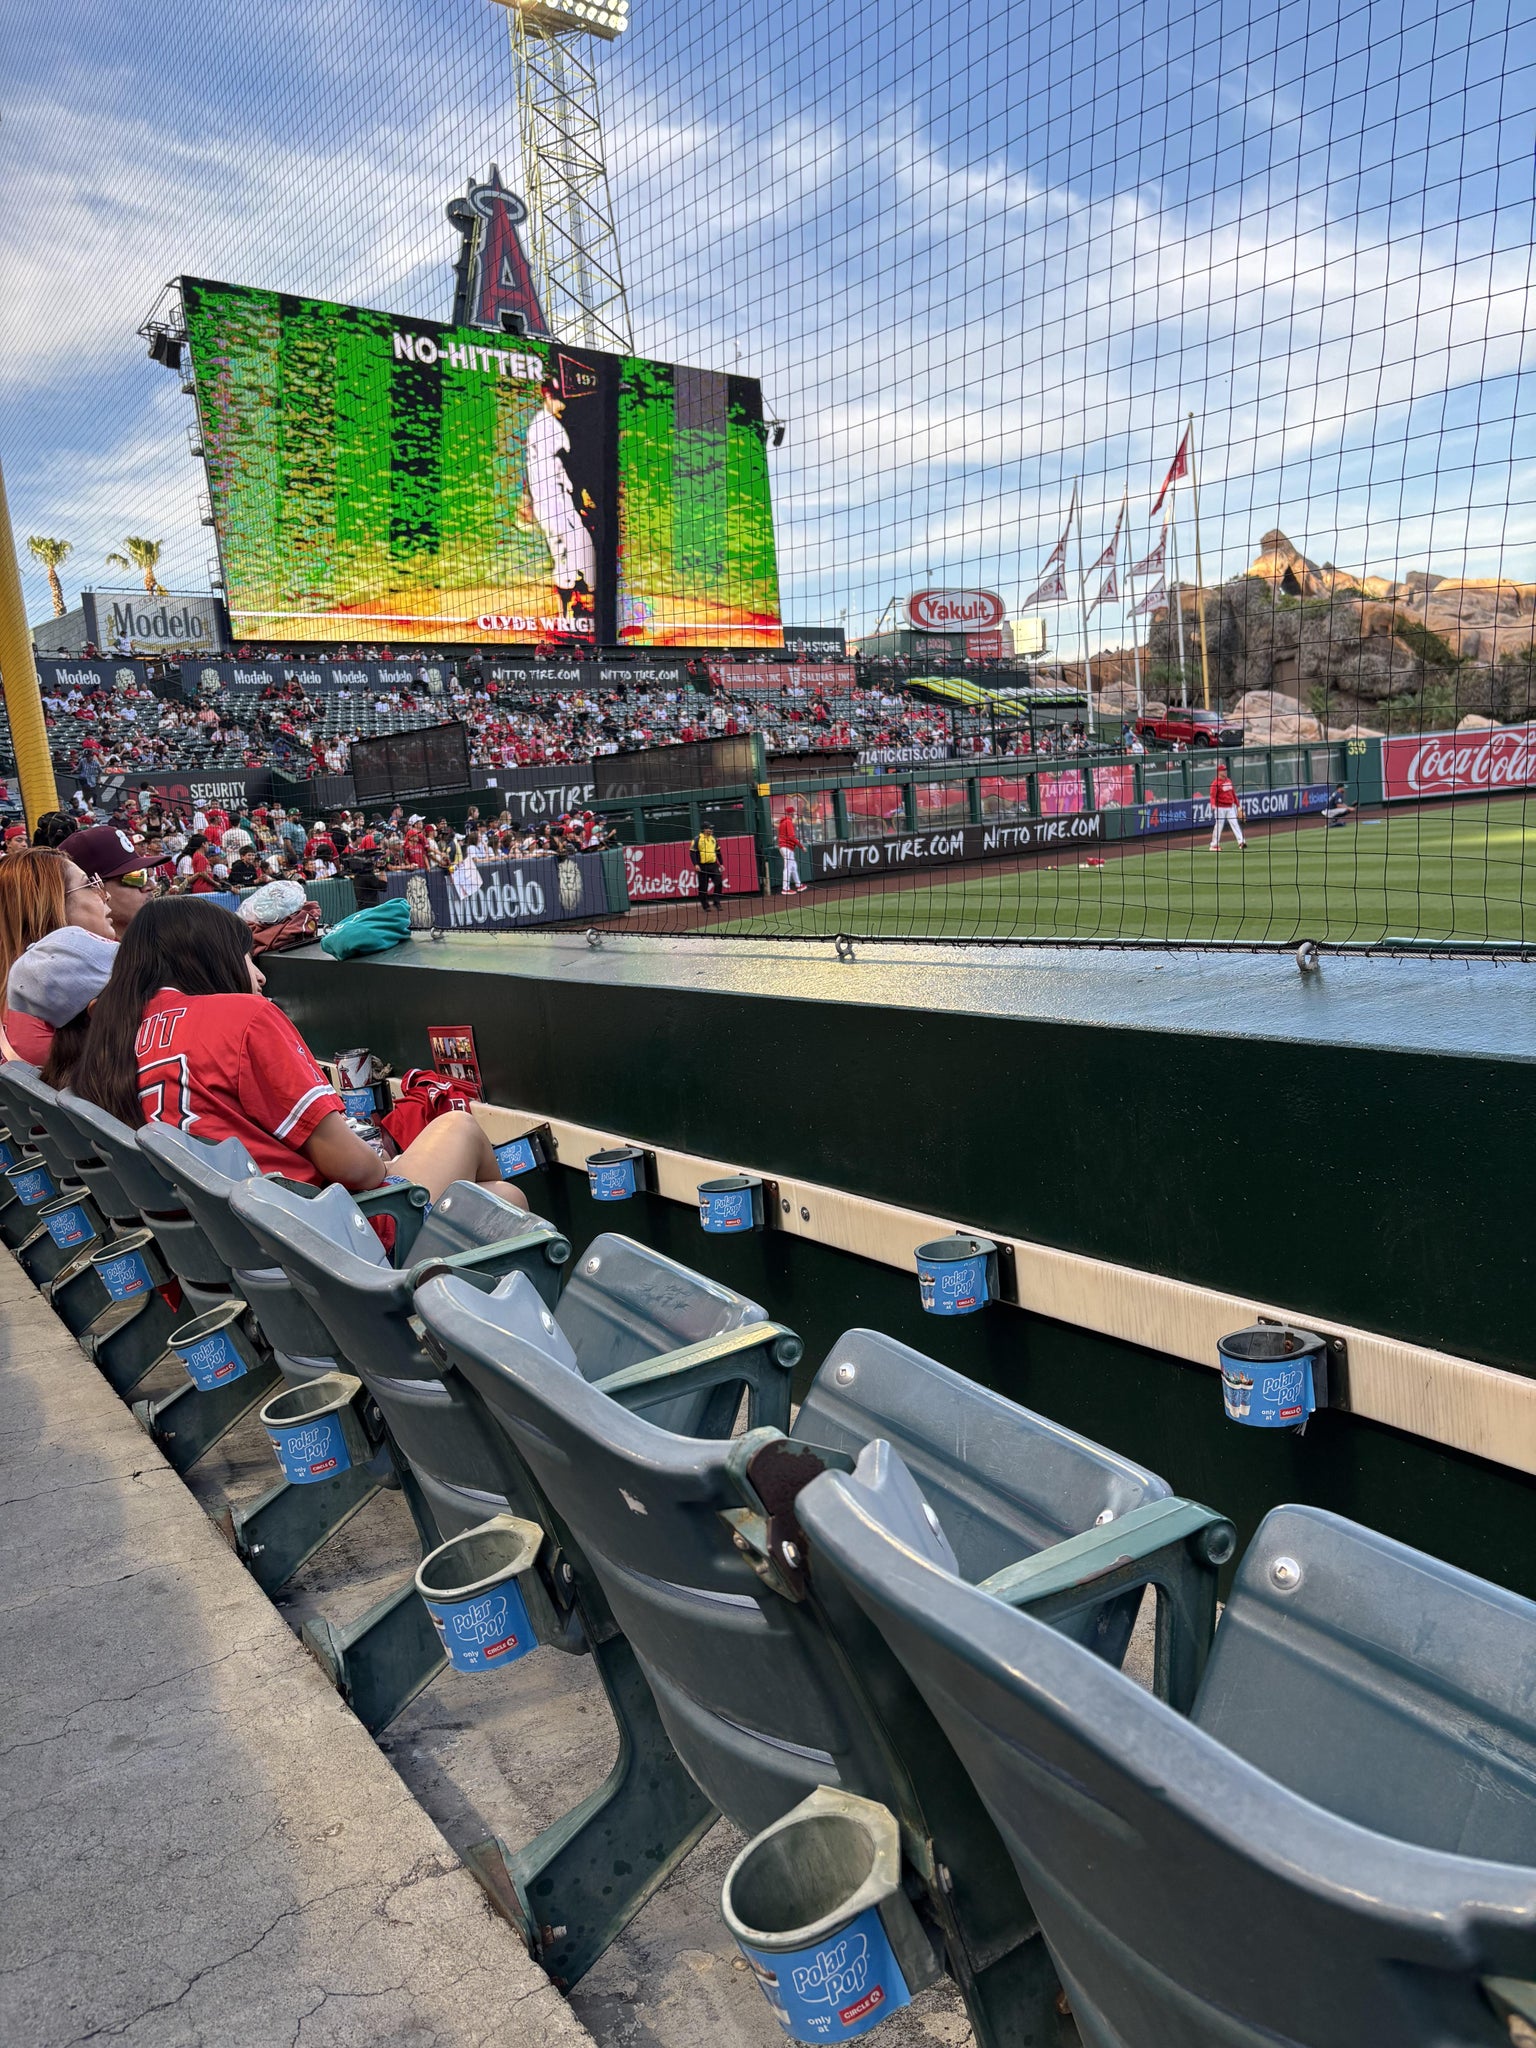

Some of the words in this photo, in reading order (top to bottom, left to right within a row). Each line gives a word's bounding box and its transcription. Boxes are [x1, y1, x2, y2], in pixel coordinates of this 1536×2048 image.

[392, 331, 547, 382] NO-HITTER
[113, 602, 202, 638] Modelo
[924, 600, 990, 621] Yakult
[477, 615, 537, 631] CLYDE
[786, 637, 811, 652] TEAM
[813, 641, 841, 653] STORE
[56, 668, 101, 685] Modelo
[234, 669, 273, 685] Modelo
[332, 669, 369, 684] Modelo
[378, 669, 413, 684] Modelo
[492, 667, 526, 681] NITTO
[529, 668, 580, 681] TIRE.COM
[600, 667, 631, 681] NITTO
[633, 668, 679, 681] TIRE.COM
[837, 672, 854, 681] INC.
[858, 745, 948, 765] 714TICKETS.COM
[1407, 731, 1536, 791] Coca-Cola
[190, 781, 246, 799] SECURITY
[983, 824, 1030, 851] NITTO
[1034, 814, 1100, 840] TIRE.COM
[822, 843, 880, 872] NITTO
[884, 830, 964, 865] TIRE.COM
[444, 869, 545, 927] Modelo
[942, 1269, 968, 1289] Polar
[953, 1279, 974, 1298] Pop
[191, 1340, 215, 1367] Polar
[206, 1347, 226, 1370] Pop
[1263, 1370, 1296, 1395] Polar
[1278, 1382, 1301, 1406] Pop
[288, 1427, 319, 1454] Polar
[304, 1438, 330, 1462] Pop
[453, 1600, 492, 1635] Polar
[475, 1611, 506, 1645] Pop
[463, 1650, 479, 1659] only
[792, 1940, 847, 1994] Polar
[825, 1955, 868, 2007] Pop
[807, 2014, 832, 2027] only
